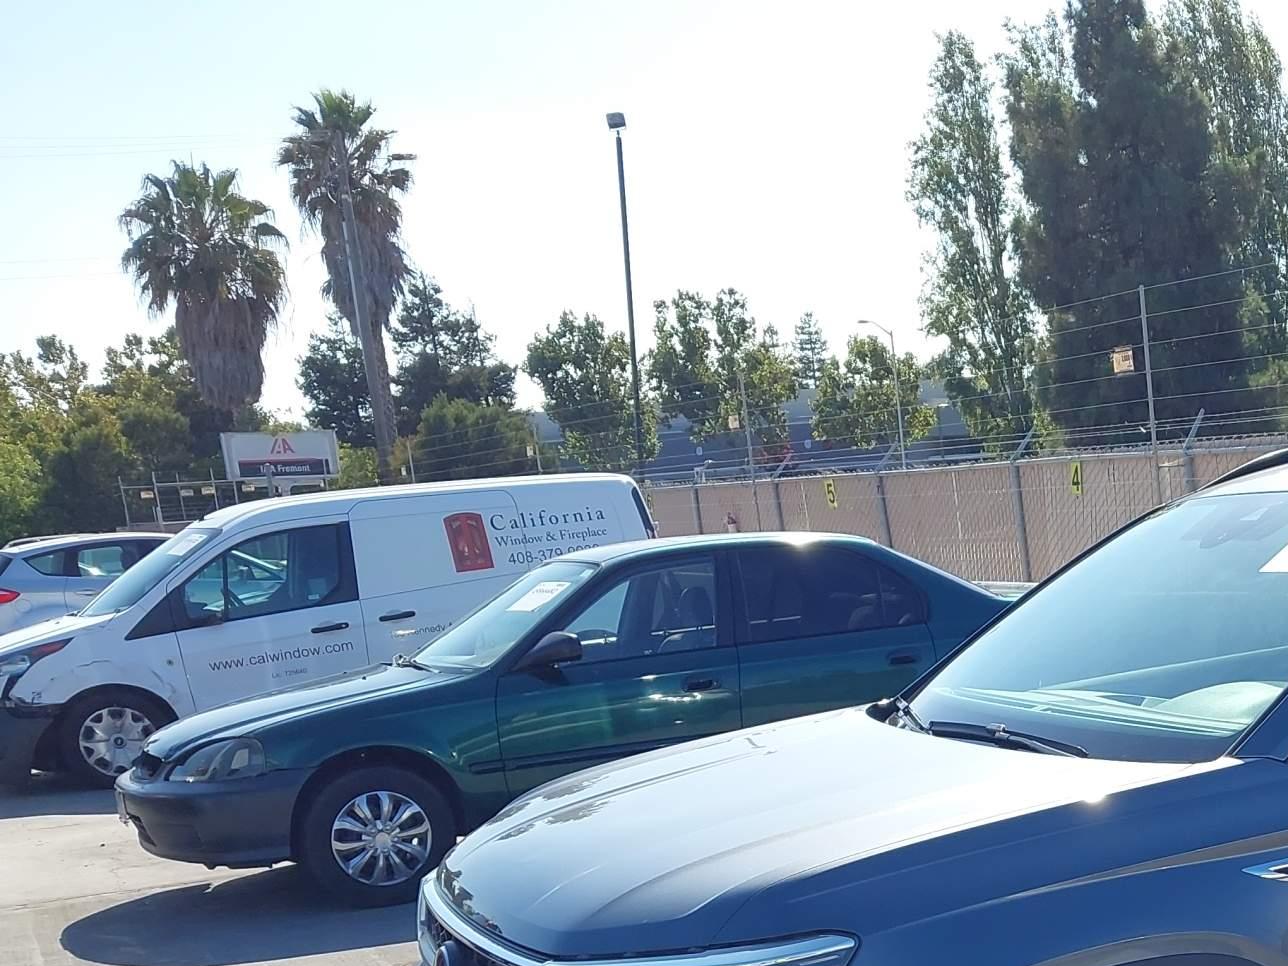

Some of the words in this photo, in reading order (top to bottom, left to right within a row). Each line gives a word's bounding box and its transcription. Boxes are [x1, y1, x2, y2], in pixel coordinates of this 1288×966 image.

[259, 464, 276, 473] IA
[277, 463, 311, 473] Fremont
[1070, 464, 1081, 492] 4
[826, 483, 836, 504] 5
[489, 506, 606, 532] California
[494, 533, 544, 548] Window
[545, 533, 558, 542] &
[558, 527, 608, 542] Fireplace
[208, 640, 355, 672] www.calwindow.com
